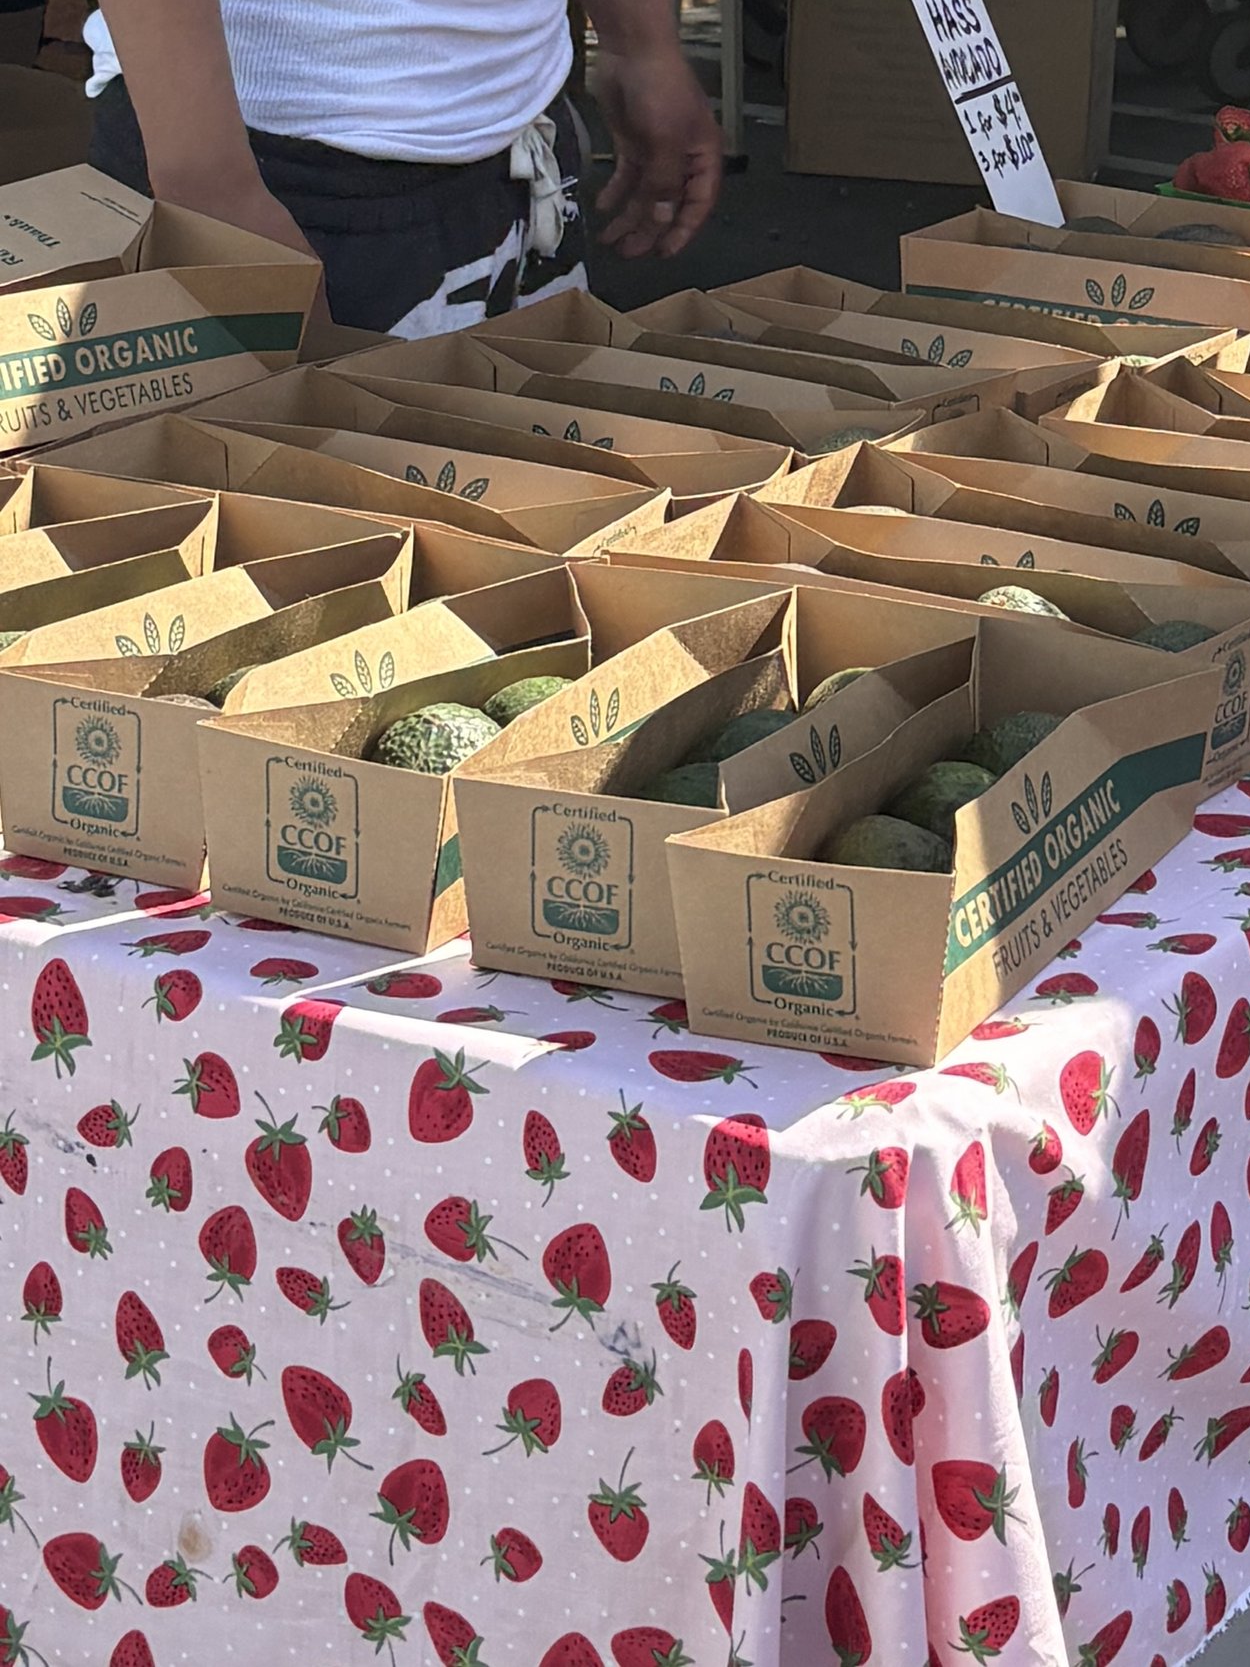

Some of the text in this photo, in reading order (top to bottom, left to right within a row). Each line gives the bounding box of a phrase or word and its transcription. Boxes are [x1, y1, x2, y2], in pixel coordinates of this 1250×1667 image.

[939, 37, 1002, 91] AVOCADO
[978, 151, 990, 172] 3
[75, 326, 199, 376] ORGANIC
[57, 397, 73, 422] &
[74, 371, 194, 418] VEGETABLES
[71, 697, 126, 717] Certified
[1214, 690, 1248, 724] CCOF
[67, 764, 128, 795] CCOF
[284, 755, 342, 779] Certified
[70, 817, 122, 838] Organic
[552, 802, 617, 823] Certified
[281, 824, 347, 856] CCOF
[954, 778, 1122, 948] CERTIFIED ORGANIC
[286, 877, 340, 900] Organic
[547, 875, 619, 906] CCOF
[767, 869, 835, 891] Certified
[991, 838, 1129, 977] FRUITS & VEGETABLES
[552, 930, 611, 952] Organic
[765, 941, 842, 972] CCOF
[773, 996, 837, 1018] Organic
